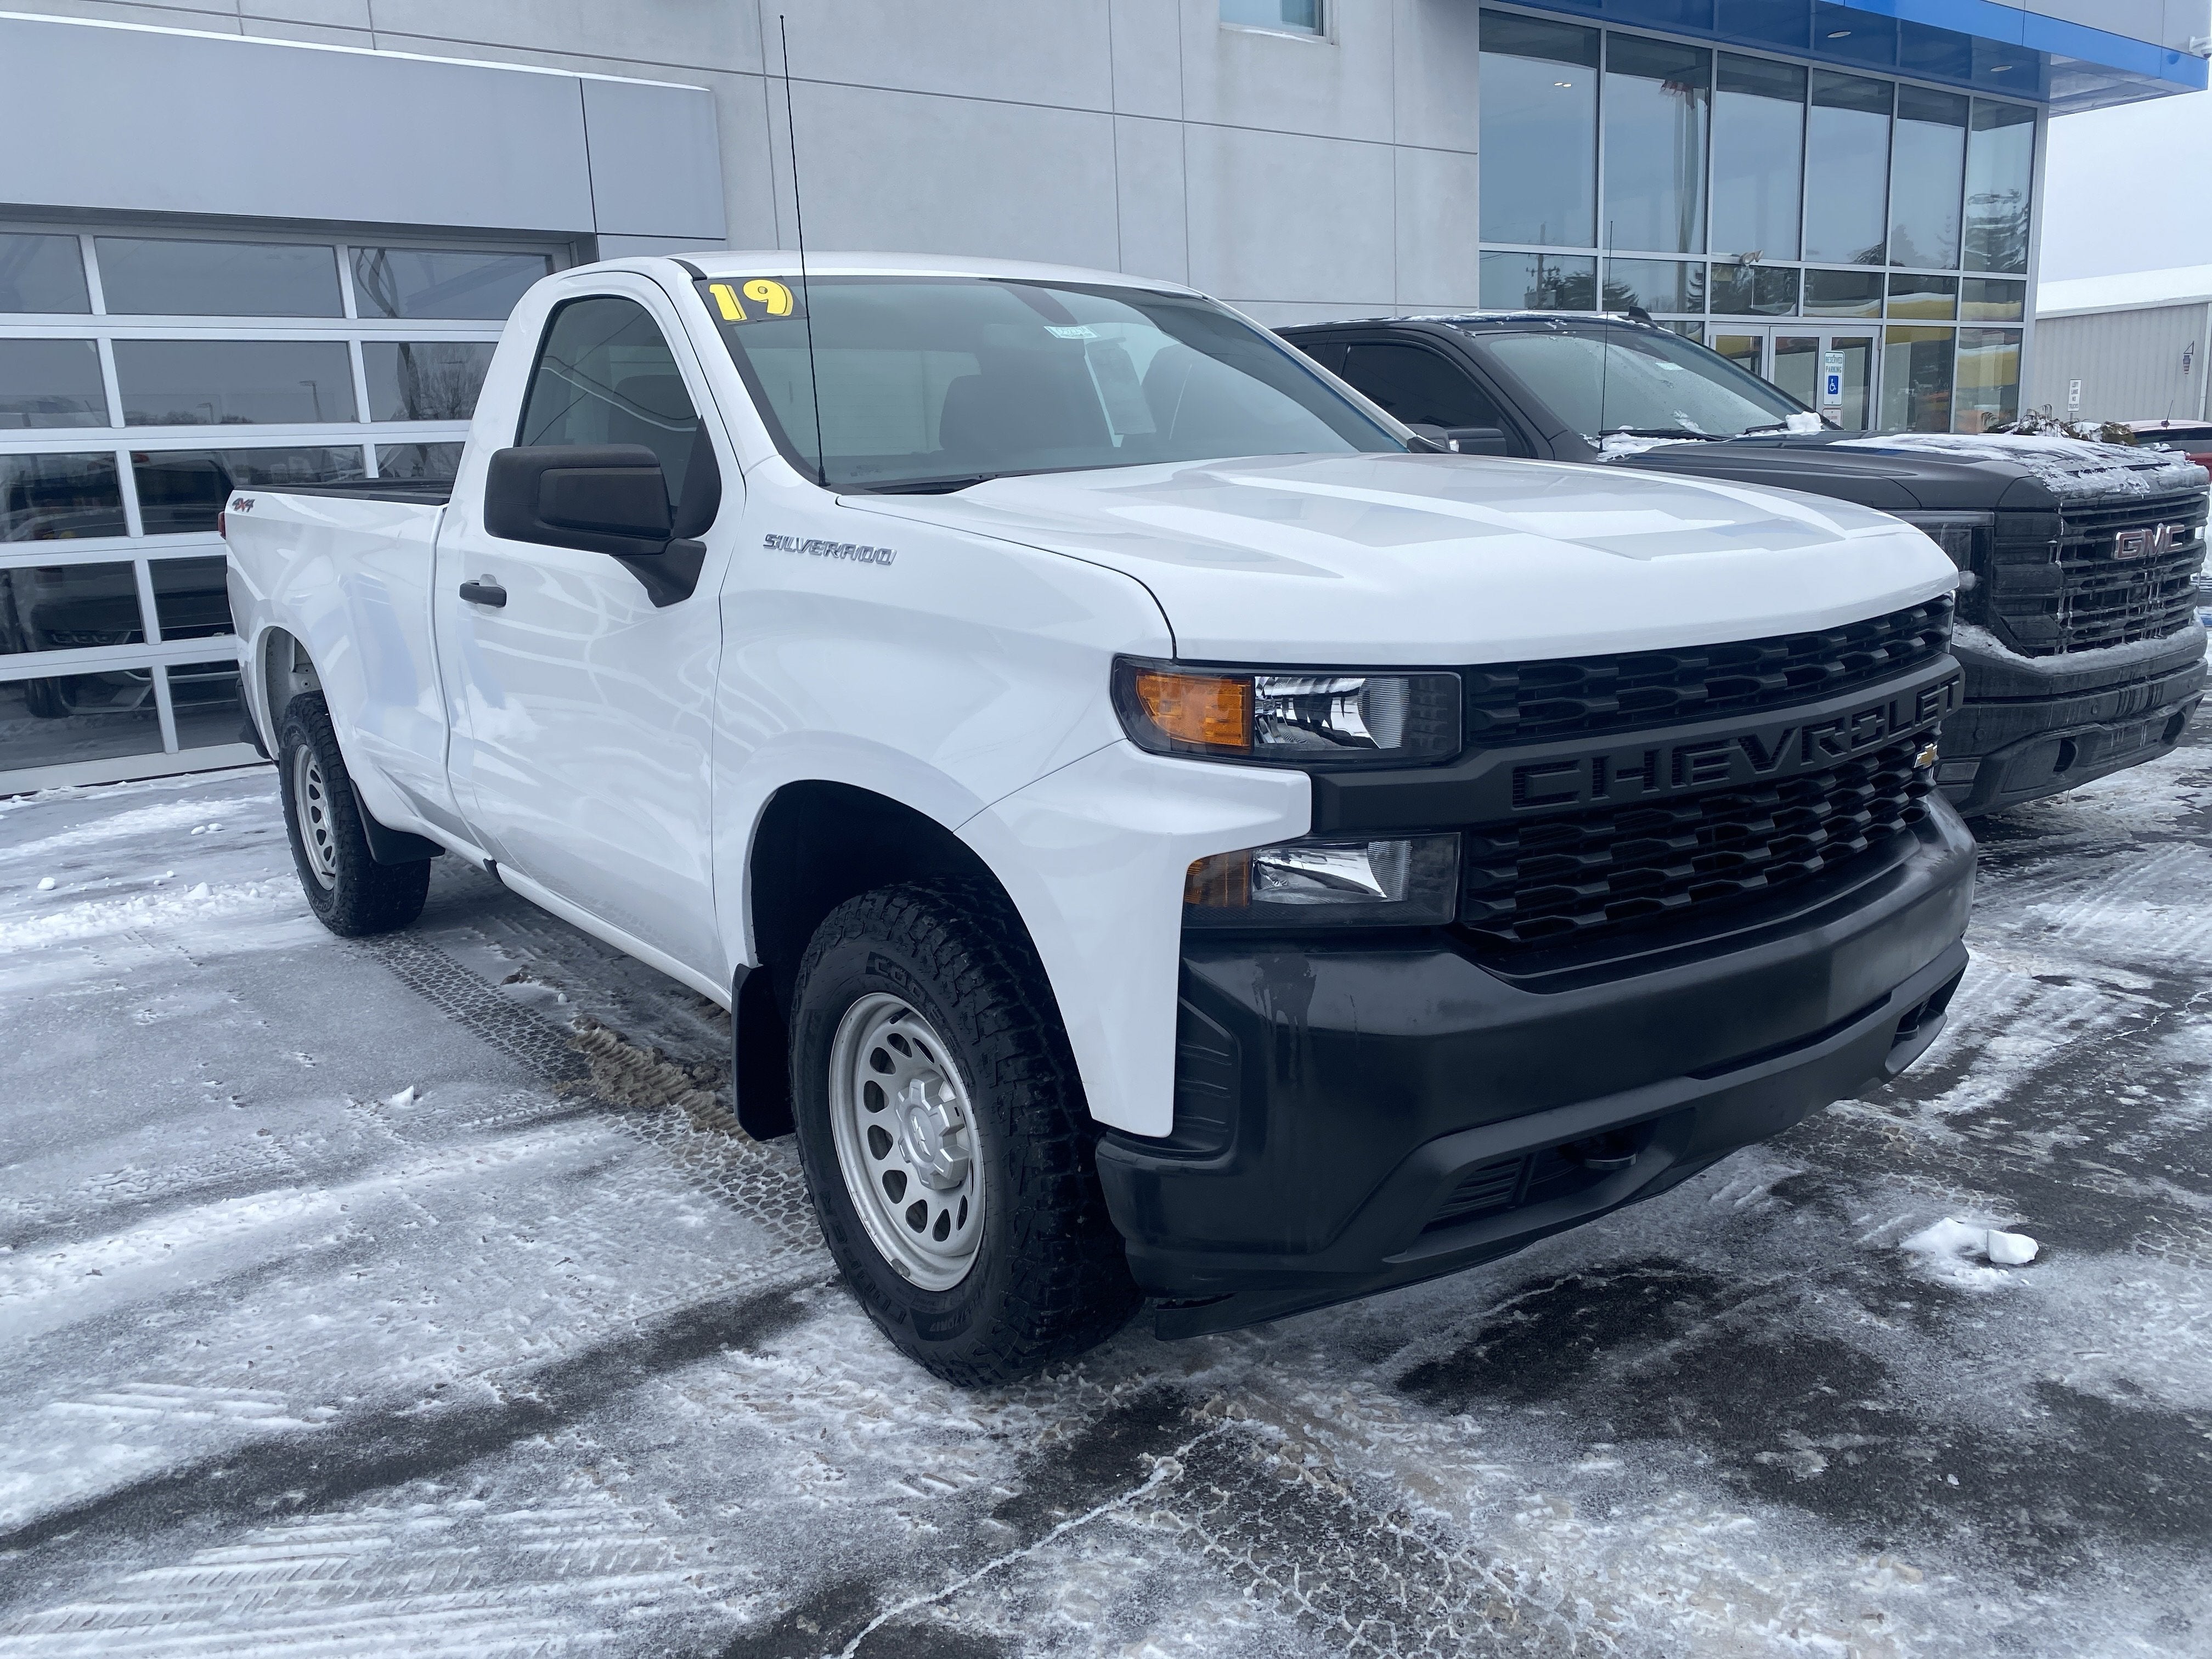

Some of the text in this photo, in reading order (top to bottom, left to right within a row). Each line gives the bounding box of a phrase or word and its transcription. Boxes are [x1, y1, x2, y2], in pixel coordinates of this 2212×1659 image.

[709, 279, 793, 321] 19
[763, 533, 898, 566] SILVERADO
[2115, 524, 2185, 560] GMC
[1511, 674, 1961, 811] CHEVROLET
